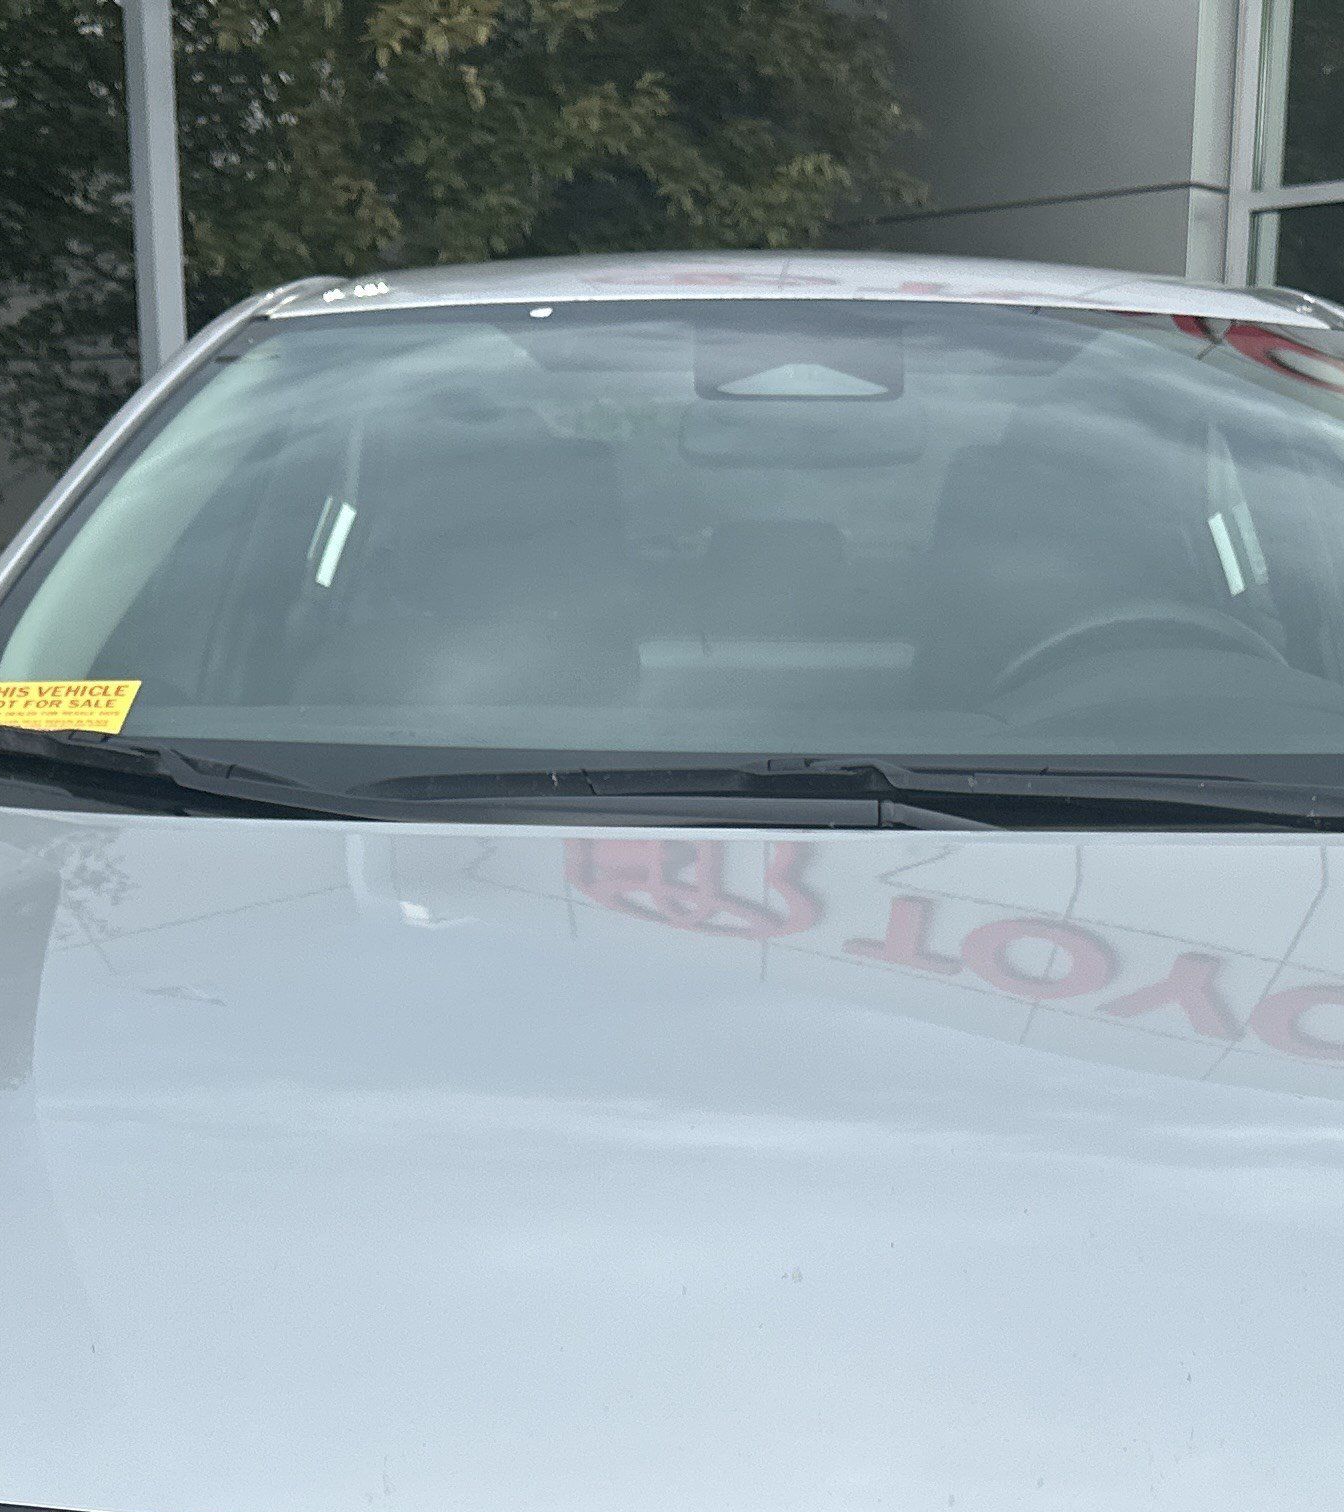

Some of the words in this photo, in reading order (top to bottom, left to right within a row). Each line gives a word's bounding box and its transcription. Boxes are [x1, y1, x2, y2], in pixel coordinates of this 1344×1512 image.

[38, 685, 129, 698] VEHICLE
[23, 699, 62, 710] FOR
[67, 698, 117, 709] SALE
